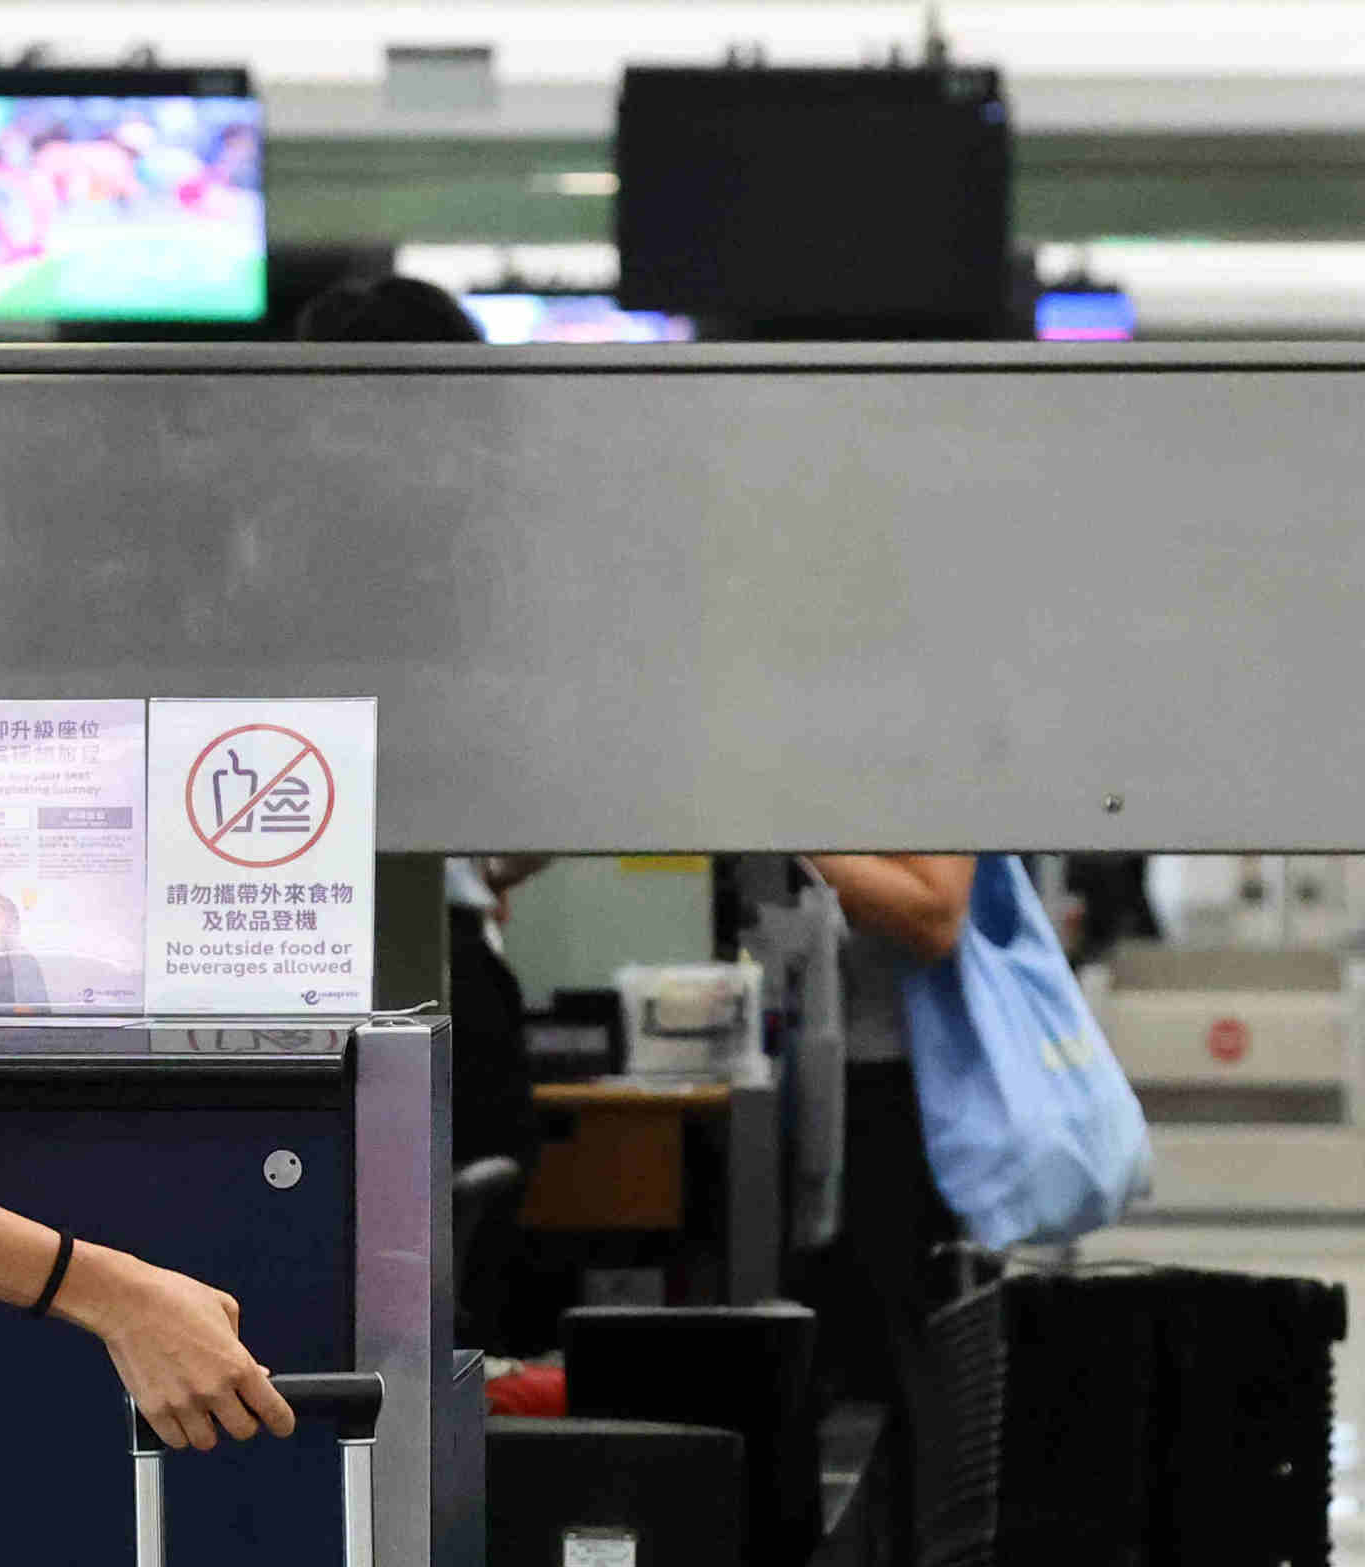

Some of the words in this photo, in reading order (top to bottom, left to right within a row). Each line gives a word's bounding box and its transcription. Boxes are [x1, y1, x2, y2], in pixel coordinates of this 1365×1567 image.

[166, 883, 354, 905] 請勿攜帶外來食物
[202, 910, 318, 932] 及飲品登機
[166, 942, 194, 956] No
[200, 941, 274, 956] outside
[280, 940, 326, 956] food
[331, 943, 353, 955] or
[166, 960, 267, 977] beverages
[273, 959, 352, 975] allowed
